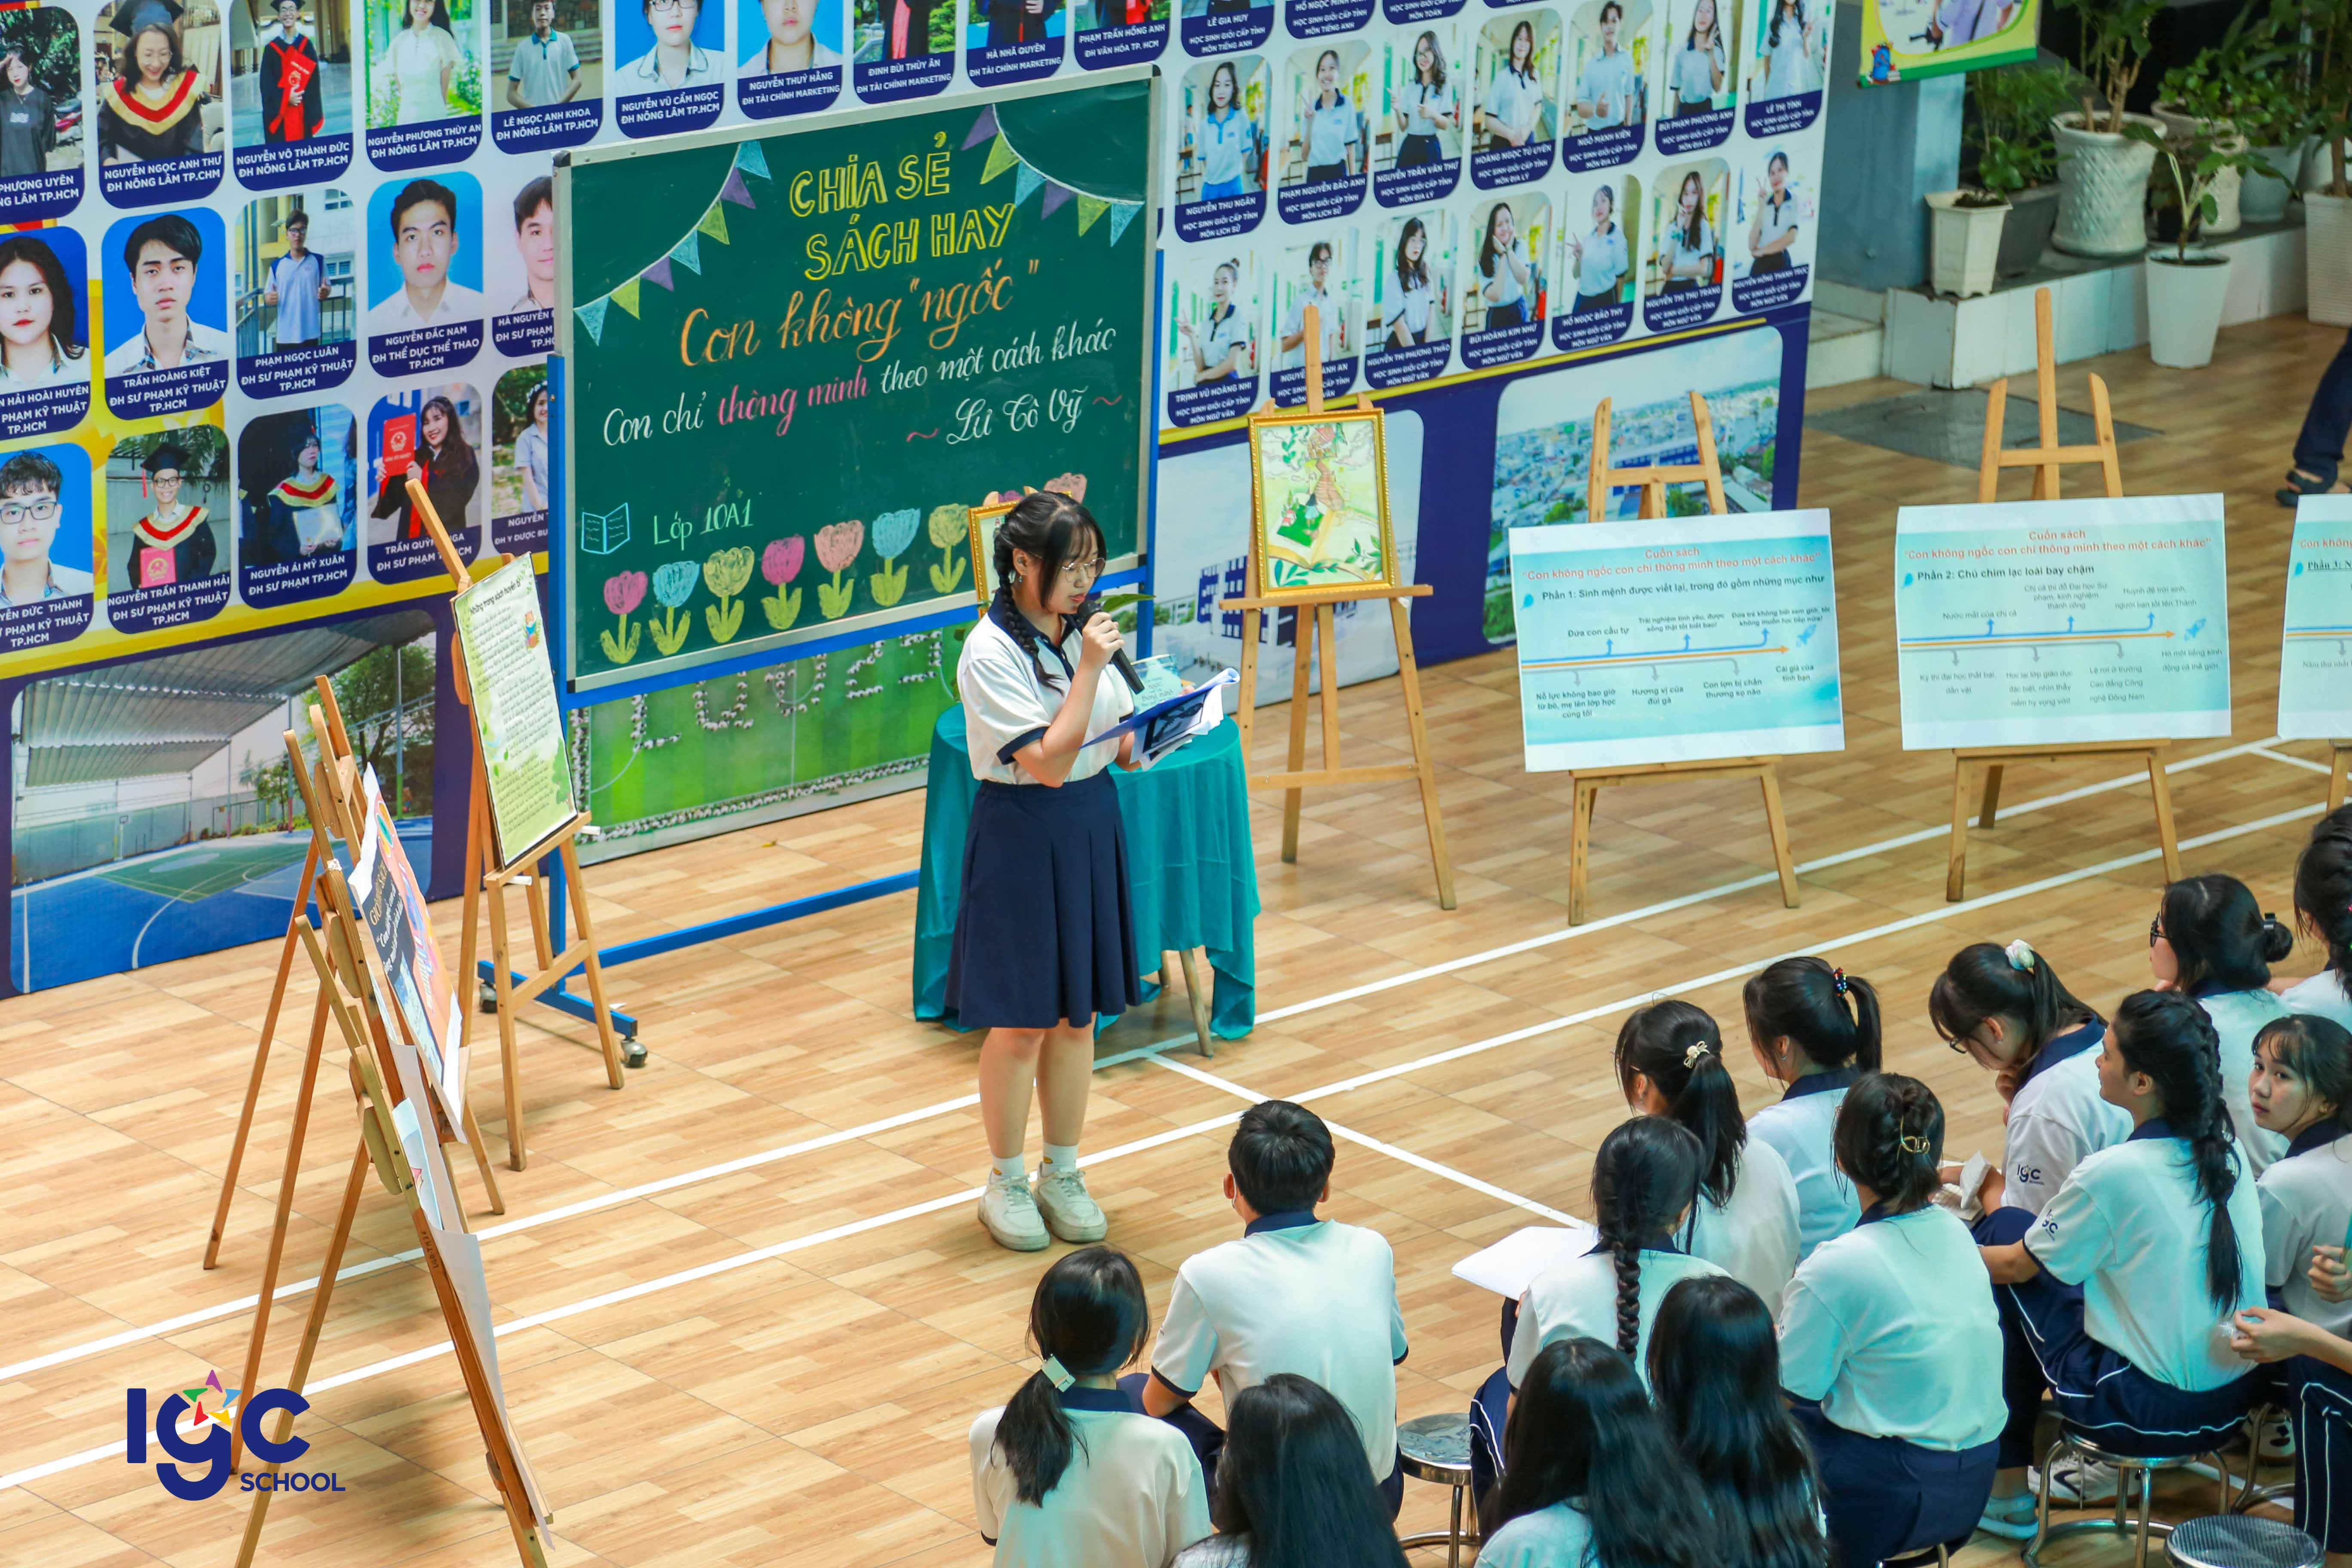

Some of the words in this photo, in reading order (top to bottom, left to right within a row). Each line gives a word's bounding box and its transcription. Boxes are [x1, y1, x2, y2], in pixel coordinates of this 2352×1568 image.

[750, 77, 784, 91] NGUYỄN
[622, 97, 657, 111] NGUYỄN
[660, 95, 671, 107] VŨ
[674, 93, 692, 105] CẨM
[694, 92, 718, 103] NGỌC
[504, 115, 514, 126] LÊ
[517, 114, 542, 125] NGỌC
[545, 112, 563, 122] ANH
[566, 109, 591, 119] KHOA
[368, 132, 404, 146] NGUYỄN
[406, 129, 442, 141] PHƯƠNG
[444, 125, 466, 136] THÙY
[469, 124, 481, 133] AN
[237, 149, 276, 165] NGUYỄN
[279, 147, 292, 159] VÕ
[295, 145, 327, 158] THÀNH
[329, 142, 349, 154] ĐỨC
[105, 163, 145, 178] NGUYỄN
[148, 162, 176, 173] NGỌC
[179, 159, 199, 170] ANH
[202, 156, 222, 167] THƯ
[896, 132, 950, 199] SẺ
[46, 175, 74, 187] UYÊN
[107, 181, 122, 191] ĐH
[125, 177, 156, 189] NÔNG
[159, 173, 180, 185] LÂM
[183, 170, 220, 182] TP.CHM
[805, 214, 919, 280] SÁCH
[931, 203, 1016, 257] HAY
[681, 308, 760, 366] Con
[777, 288, 902, 362] không
[256, 355, 282, 366] PHẠM
[285, 351, 311, 362] NGỌC
[314, 346, 338, 358] LUÂN
[372, 354, 386, 364] ĐH
[389, 348, 407, 361] THỂ
[410, 347, 429, 358] DỤC
[432, 341, 450, 354] THỂ
[453, 339, 479, 351] THAO
[124, 374, 149, 387] TRẦN
[152, 371, 187, 383] HOÀNG
[190, 368, 211, 378] KIỆT
[603, 408, 653, 445] Con
[663, 391, 707, 434] chỉ
[718, 385, 797, 436] thông
[808, 364, 870, 406] minh
[881, 360, 928, 393] theo
[937, 346, 984, 382] một
[992, 331, 1044, 372] cách
[1052, 318, 1116, 361] khác
[8, 392, 24, 403] HẢI
[28, 389, 52, 401] HOÀI
[55, 385, 89, 398] HUYÊN
[110, 395, 124, 405] ĐH
[128, 392, 141, 402] SƯ
[144, 388, 173, 400] PHẠM
[176, 384, 189, 396] KỸ
[192, 380, 225, 394] THUẬT
[150, 400, 187, 412] TP.HCM
[654, 511, 692, 551] Lớp
[699, 499, 754, 535] 10A1
[2061, 530, 2086, 539] sách
[1676, 547, 1700, 558] sách
[251, 564, 288, 579] NGUYỄN
[292, 562, 300, 572] ÁI
[303, 559, 316, 570] MỸ
[320, 554, 344, 567] XUÂN
[1553, 568, 1584, 579] không
[1616, 566, 1634, 574] con
[1688, 560, 1713, 570] minh
[1716, 558, 1739, 568] theo
[1764, 555, 1787, 565] cách
[1918, 570, 1942, 580] Phần
[1981, 568, 2005, 578] chim
[107, 590, 147, 606] NGUYỄN
[150, 585, 176, 598] TRẦN
[179, 580, 211, 593] THANH
[214, 576, 229, 587] HẢI
[249, 585, 263, 595] ĐH
[266, 582, 279, 592] SƯ
[282, 577, 309, 589] PHẠM
[312, 570, 347, 584] TP.HCM
[1542, 590, 1565, 600] Phần
[1579, 588, 1599, 598] Sinh
[1602, 587, 1626, 597] mệnh
[1629, 586, 1653, 596] được
[1690, 582, 1714, 591] trong
[1717, 580, 1728, 589] đó
[1753, 577, 1782, 588] những
[1806, 574, 1825, 583] như
